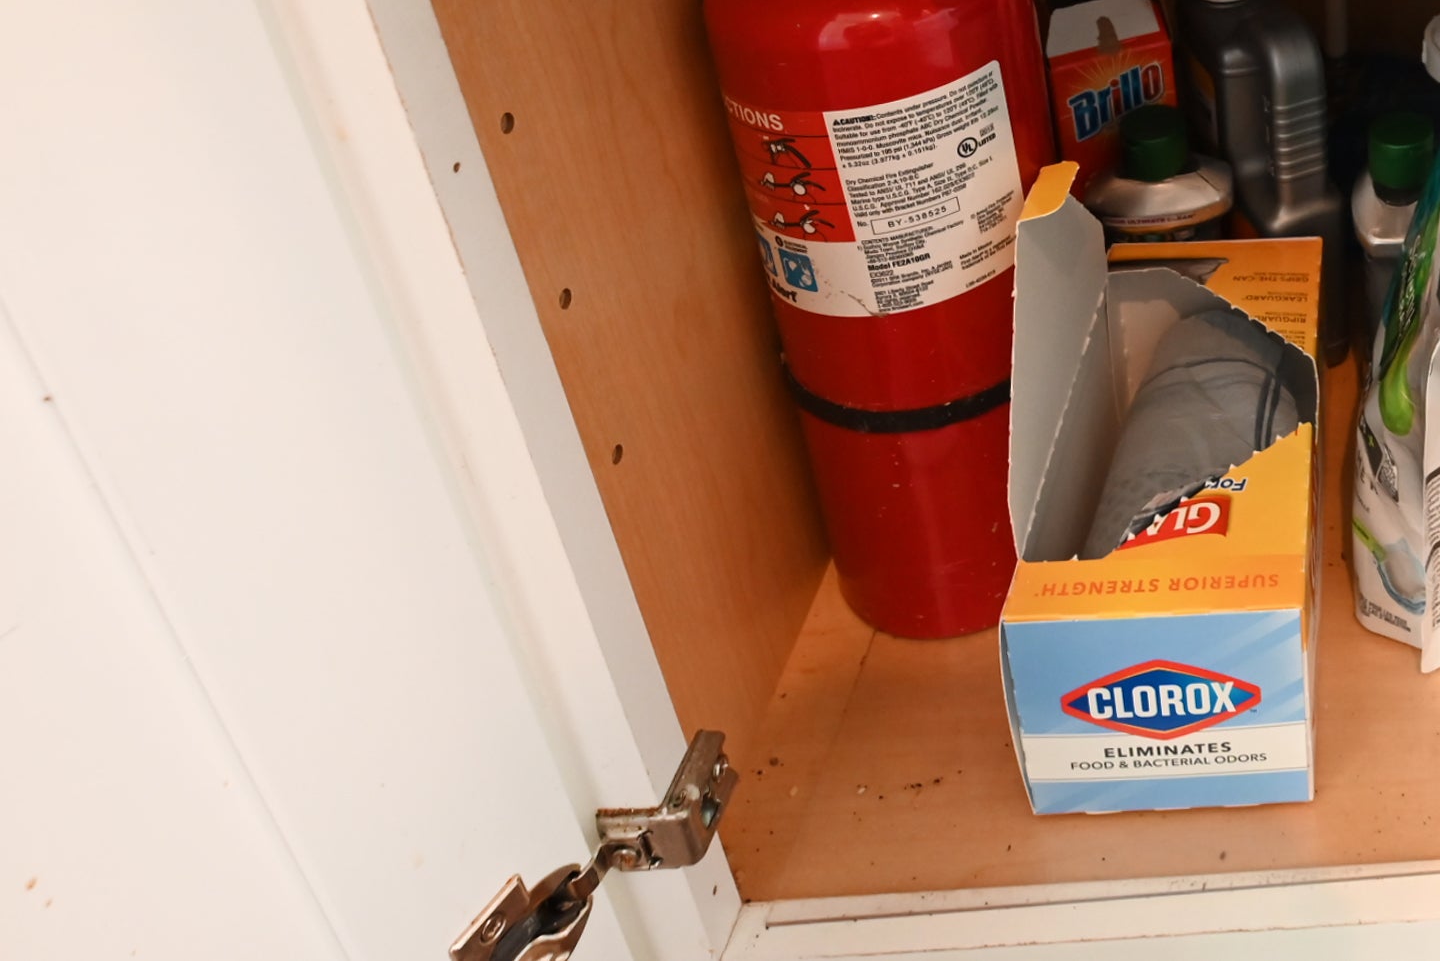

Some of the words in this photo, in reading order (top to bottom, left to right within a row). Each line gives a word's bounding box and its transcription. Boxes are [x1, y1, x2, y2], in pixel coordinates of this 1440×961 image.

[1068, 61, 1164, 142] Brillo
[898, 163, 933, 176] Extinguisher
[847, 183, 885, 191] Classification
[1145, 502, 1221, 536] GLA
[1169, 574, 1278, 591] SUPERIOR
[1087, 681, 1236, 720] CLOROX
[1104, 741, 1232, 758] ELIMINATES
[1071, 760, 1114, 771] FOOD
[1119, 760, 1128, 768] &
[1133, 756, 1210, 768] BACTERIAL
[1215, 753, 1267, 765] ODORS
